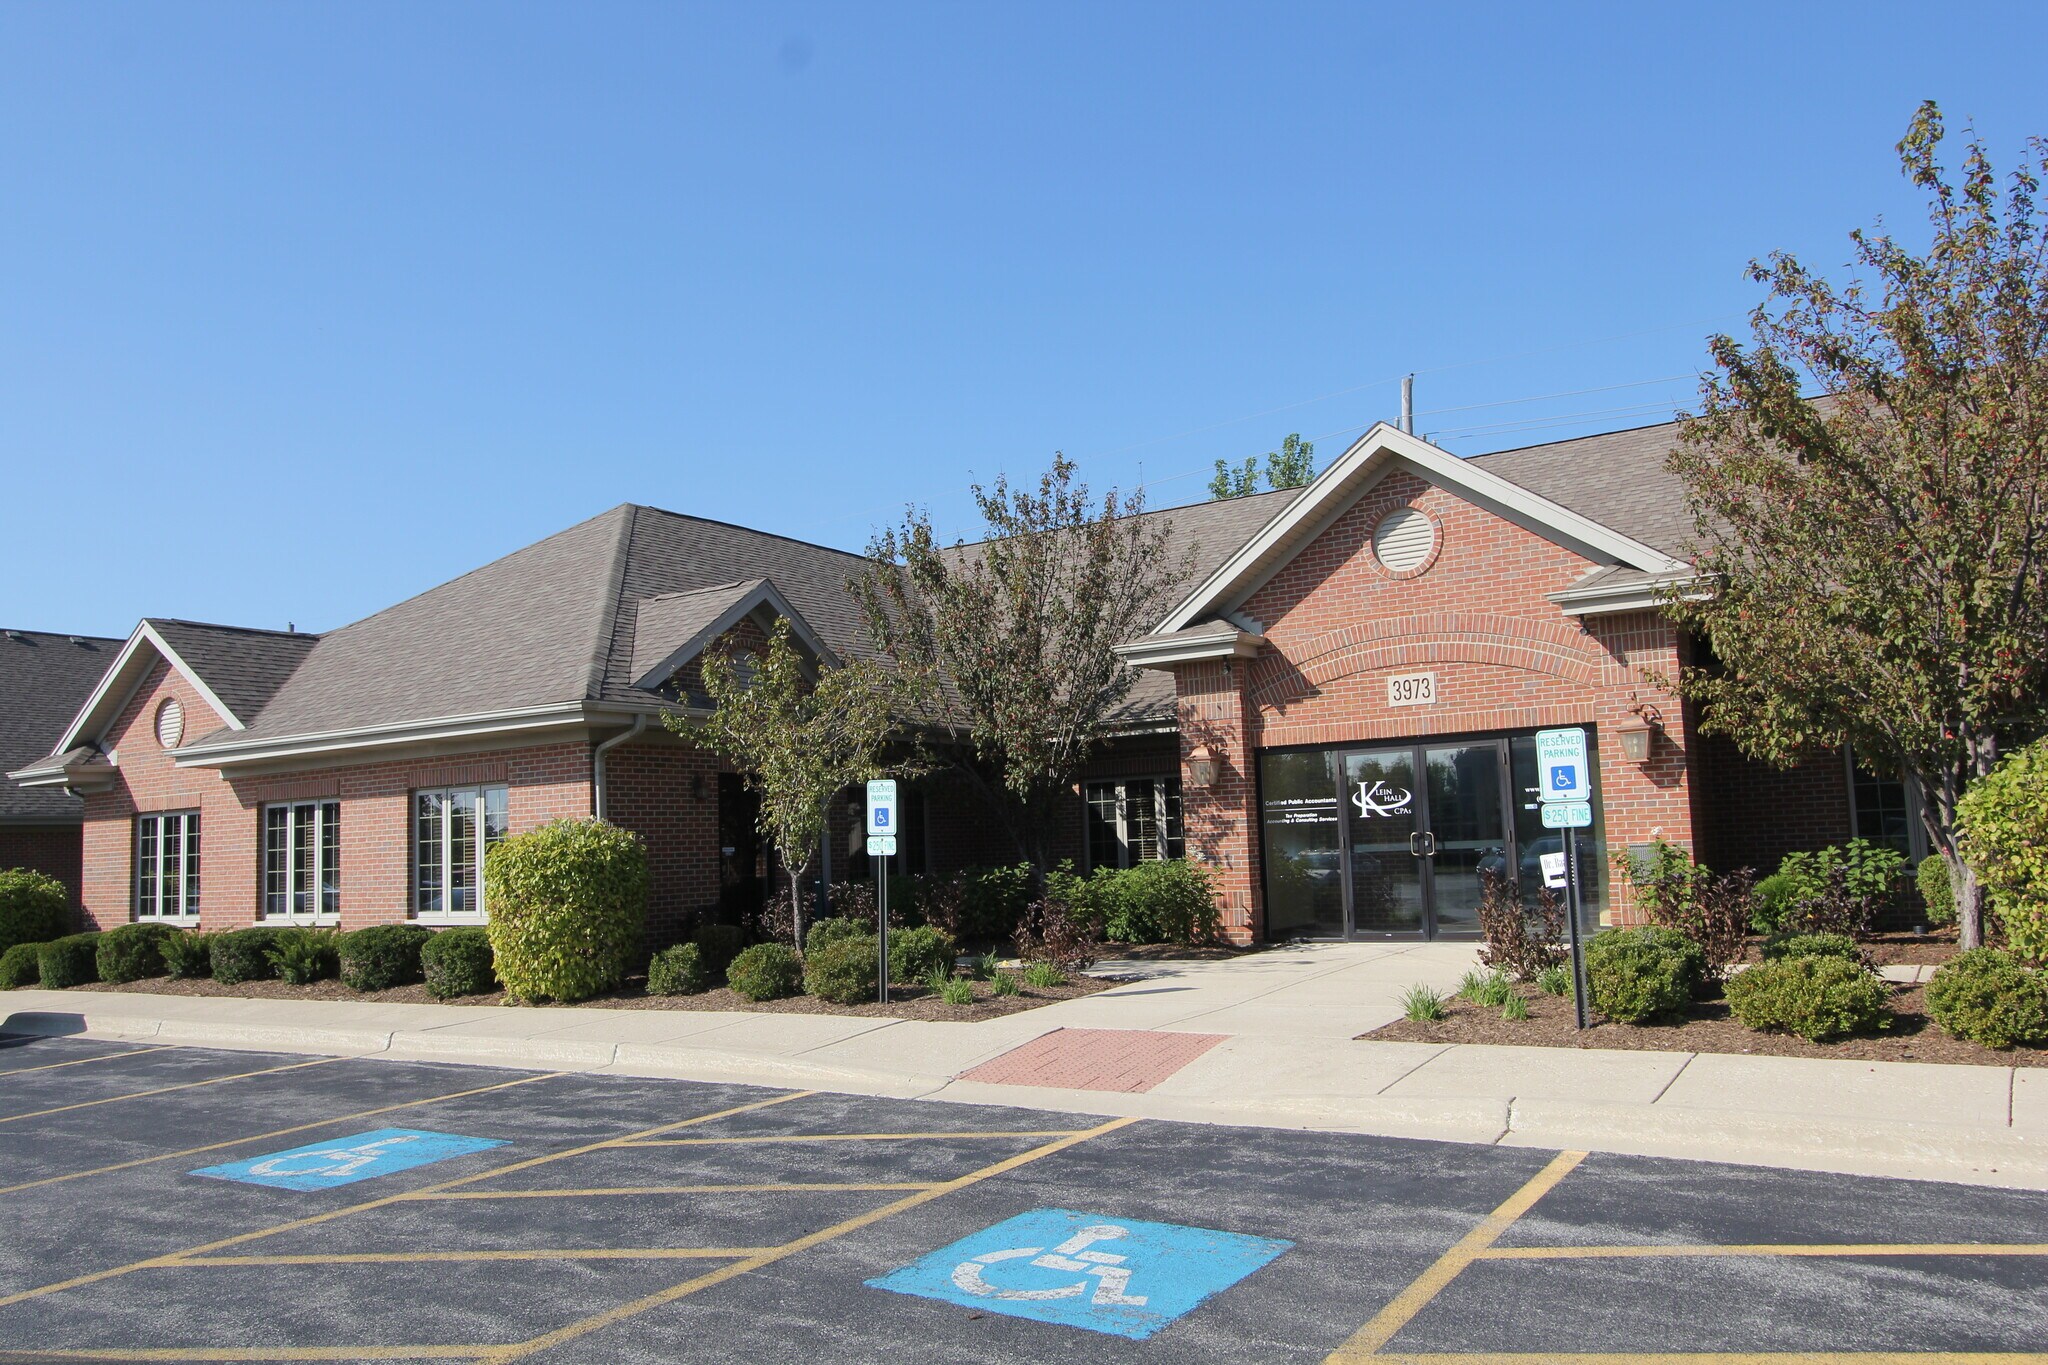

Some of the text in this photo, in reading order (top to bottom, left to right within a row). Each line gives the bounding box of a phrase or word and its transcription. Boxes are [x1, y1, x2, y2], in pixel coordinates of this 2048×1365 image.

[1393, 678, 1430, 701] 3973
[1540, 735, 1581, 747] RESERVED
[1544, 748, 1580, 758] PARKING
[869, 785, 895, 793] RESERVED
[1572, 808, 1590, 821] FINE
[884, 840, 895, 850] FINE
